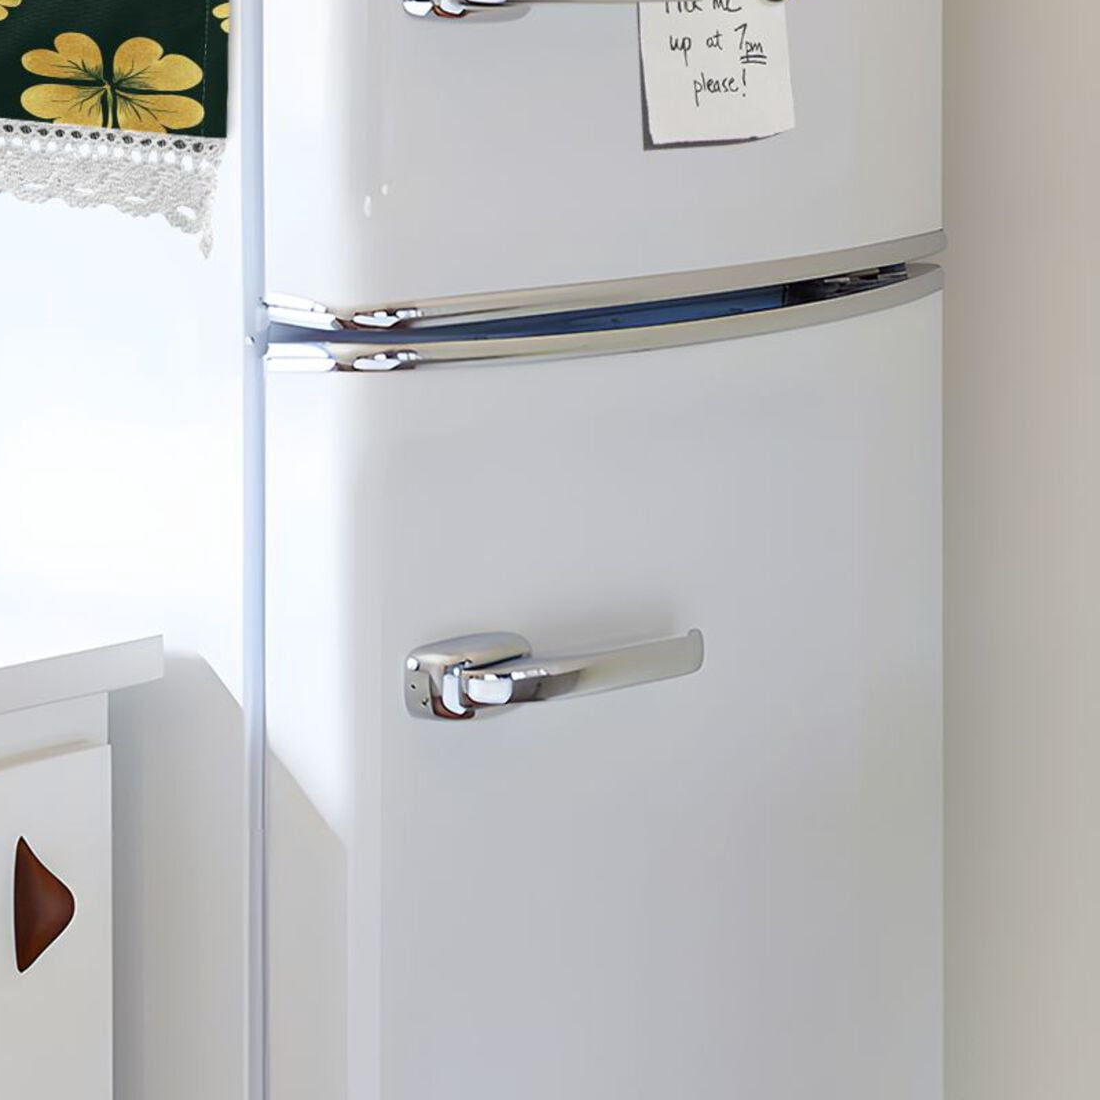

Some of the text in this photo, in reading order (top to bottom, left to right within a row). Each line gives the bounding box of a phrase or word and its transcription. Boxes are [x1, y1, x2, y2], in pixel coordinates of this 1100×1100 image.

[669, 35, 692, 67] up
[705, 30, 724, 51] at
[693, 68, 747, 107] please!
